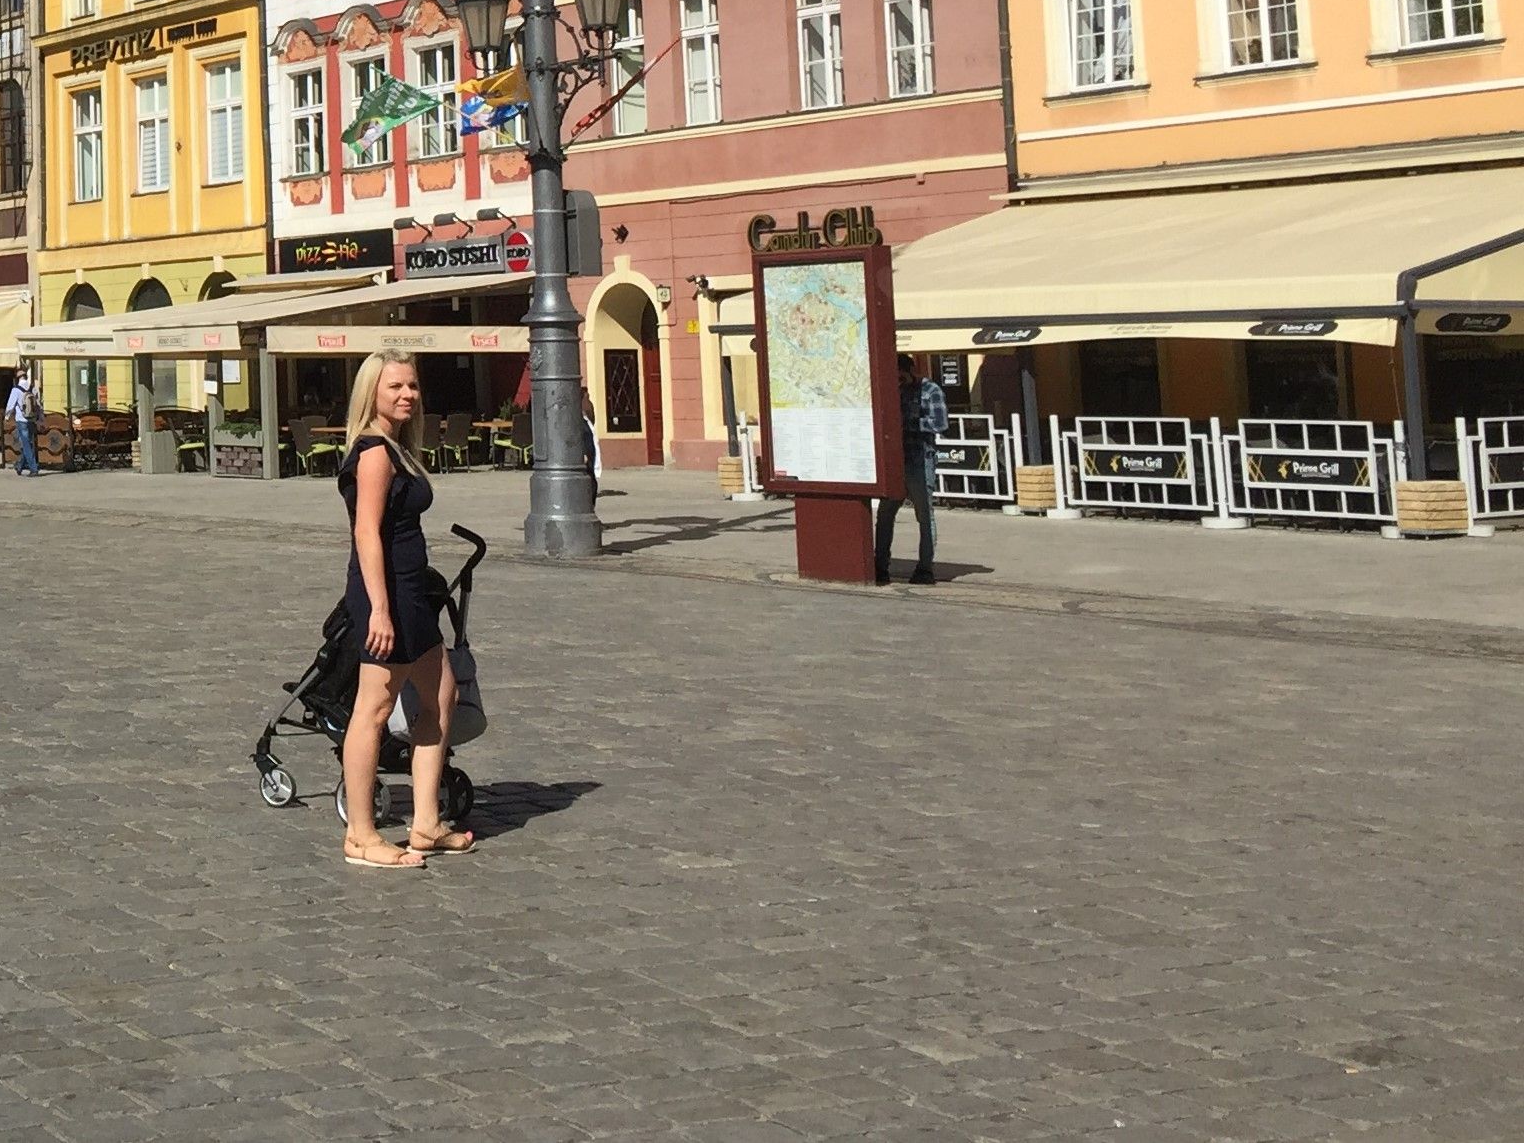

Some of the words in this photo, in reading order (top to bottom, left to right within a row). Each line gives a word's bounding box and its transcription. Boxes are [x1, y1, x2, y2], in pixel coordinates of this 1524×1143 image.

[747, 210, 822, 252] Candy
[822, 205, 883, 247] Club
[406, 248, 448, 271] KOBO
[448, 243, 502, 268] SUSHI
[1121, 456, 1145, 468] Prime
[1145, 456, 1163, 469] Grill
[1292, 461, 1318, 474] Prime
[1319, 462, 1340, 476] Grill
